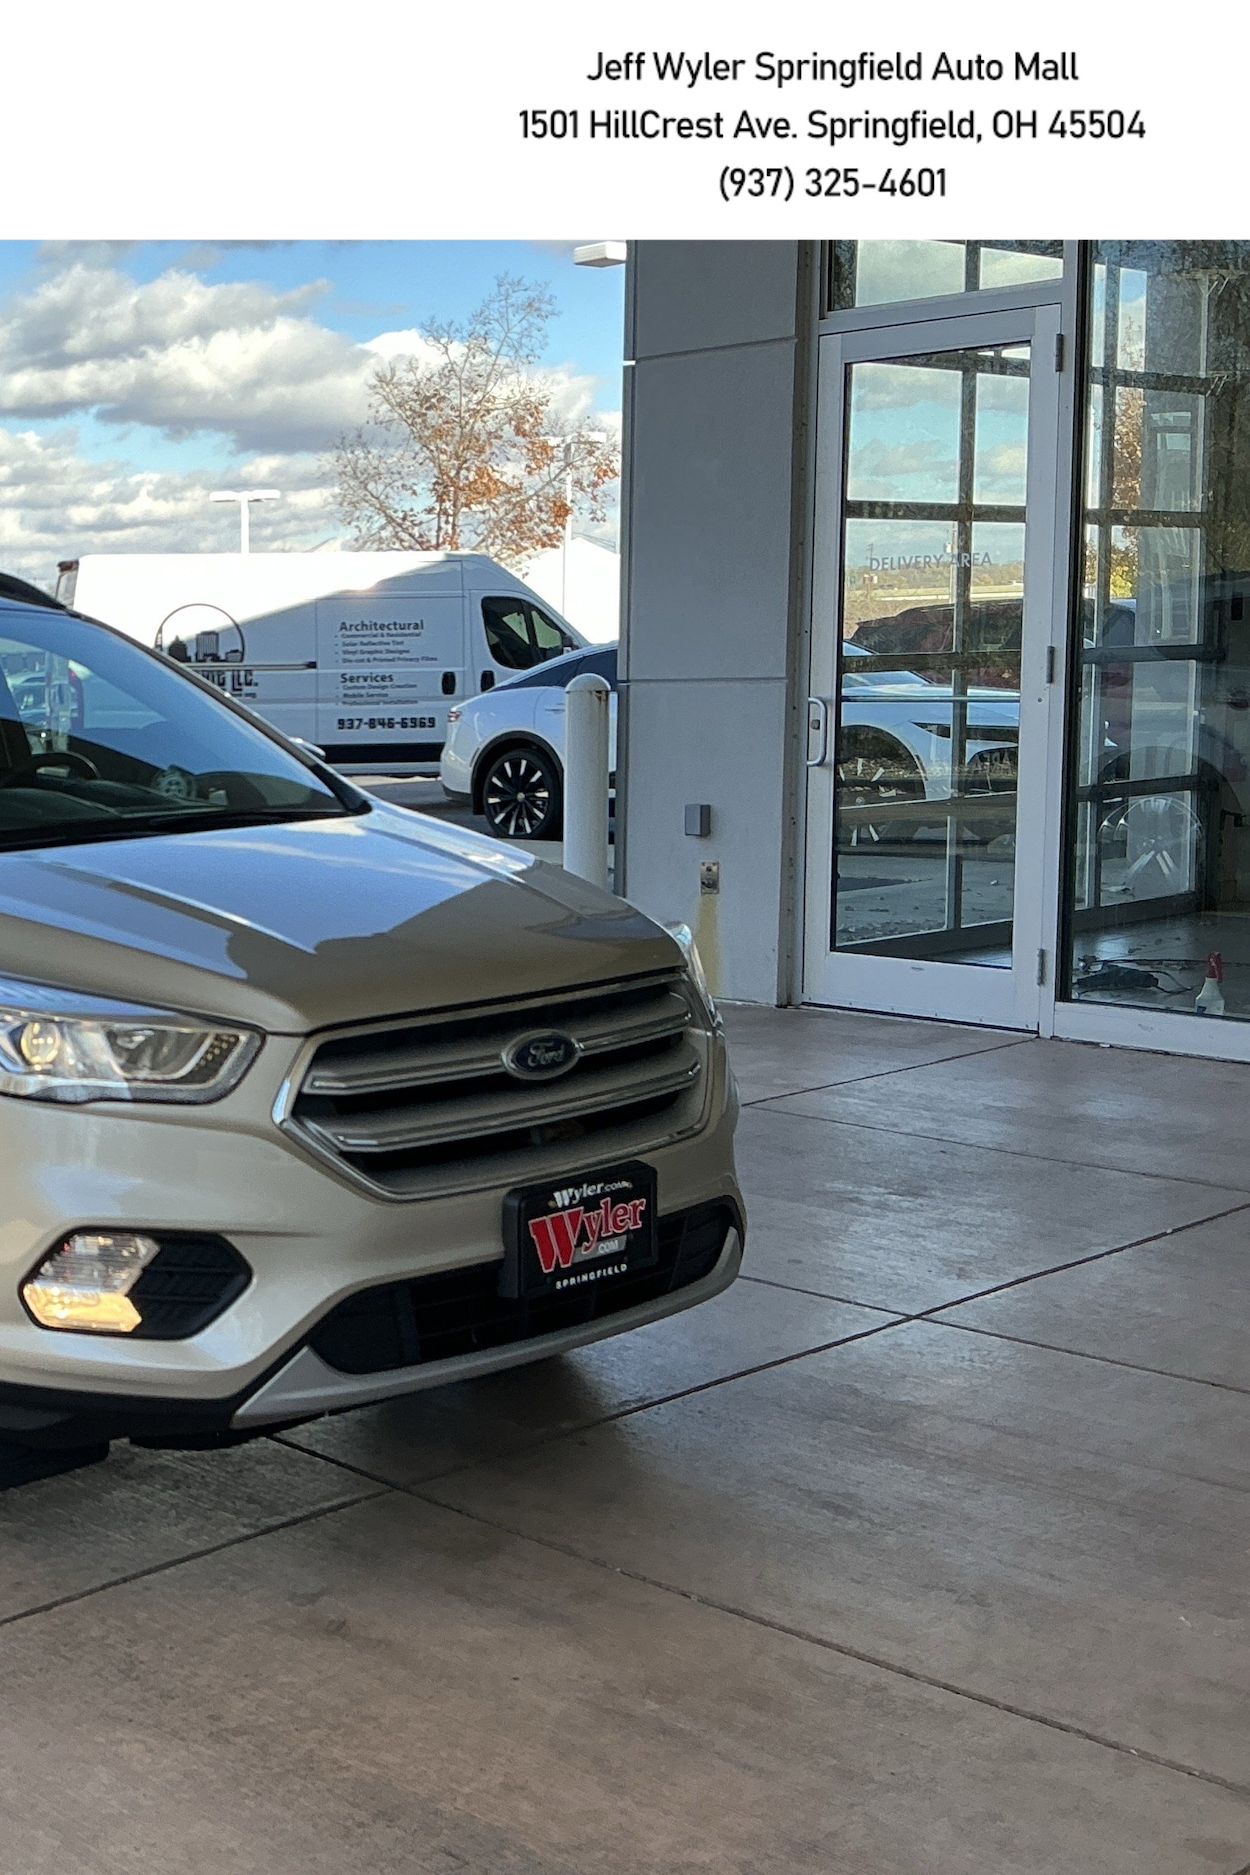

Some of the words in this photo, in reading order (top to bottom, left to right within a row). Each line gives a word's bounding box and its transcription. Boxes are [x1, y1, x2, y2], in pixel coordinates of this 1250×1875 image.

[870, 554, 943, 571] DELIVERY
[950, 552, 992, 567] AREA
[339, 619, 424, 632] Architectural
[340, 672, 394, 683] Services
[338, 717, 436, 729] 937-846-6969
[528, 1197, 646, 1273] Wyler
[556, 1264, 627, 1290] SPRINGFIELD
